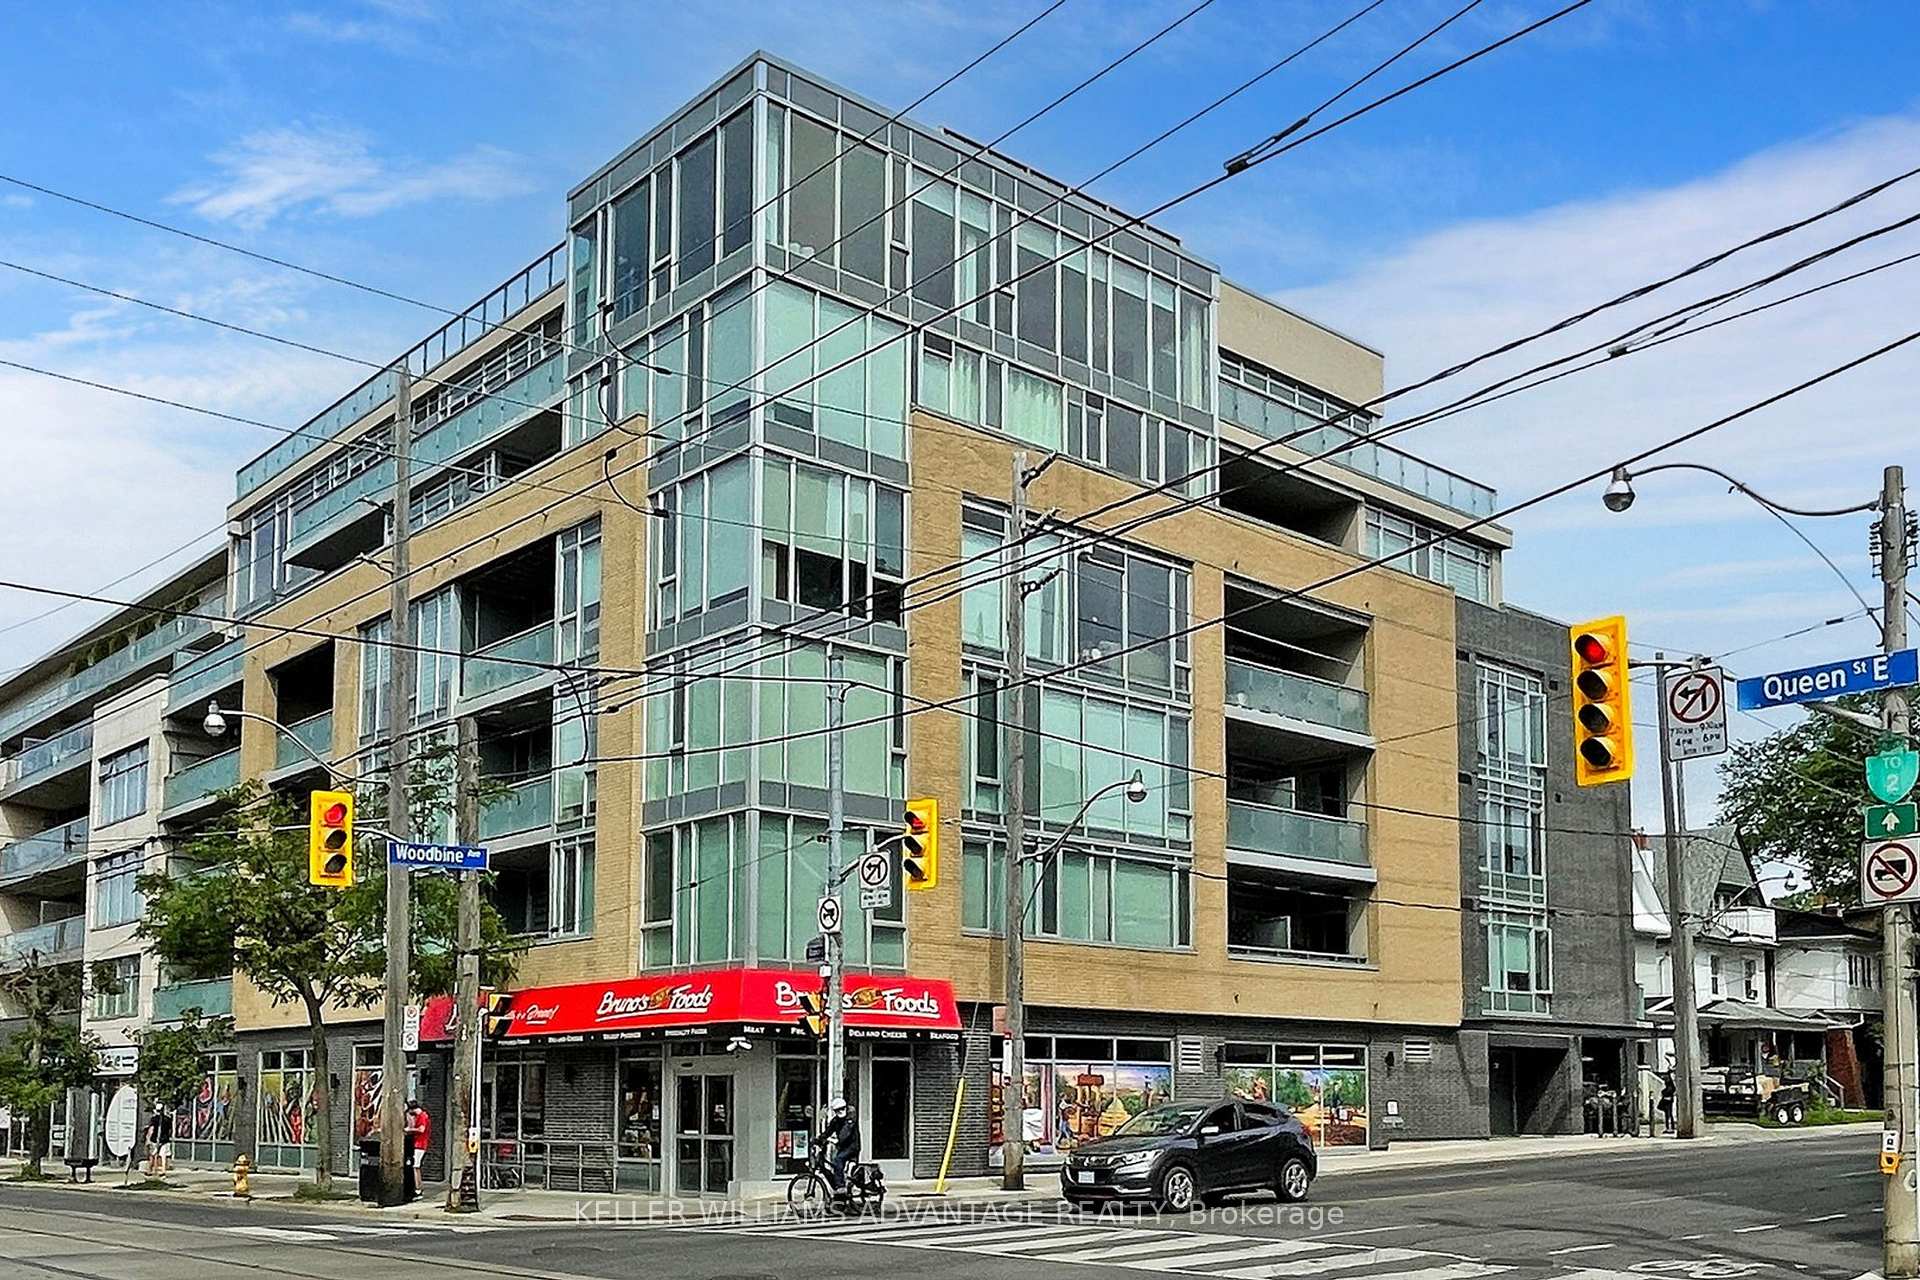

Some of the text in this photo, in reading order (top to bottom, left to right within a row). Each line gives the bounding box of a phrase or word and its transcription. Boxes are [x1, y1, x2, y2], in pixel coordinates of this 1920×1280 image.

[1763, 655, 1889, 700] Queen St E
[1882, 756, 1902, 769] TO
[1886, 773, 1899, 795] 2
[395, 844, 464, 863] Woodbine
[596, 984, 713, 1014] Bruno's Foods
[882, 988, 938, 1014] Foods
